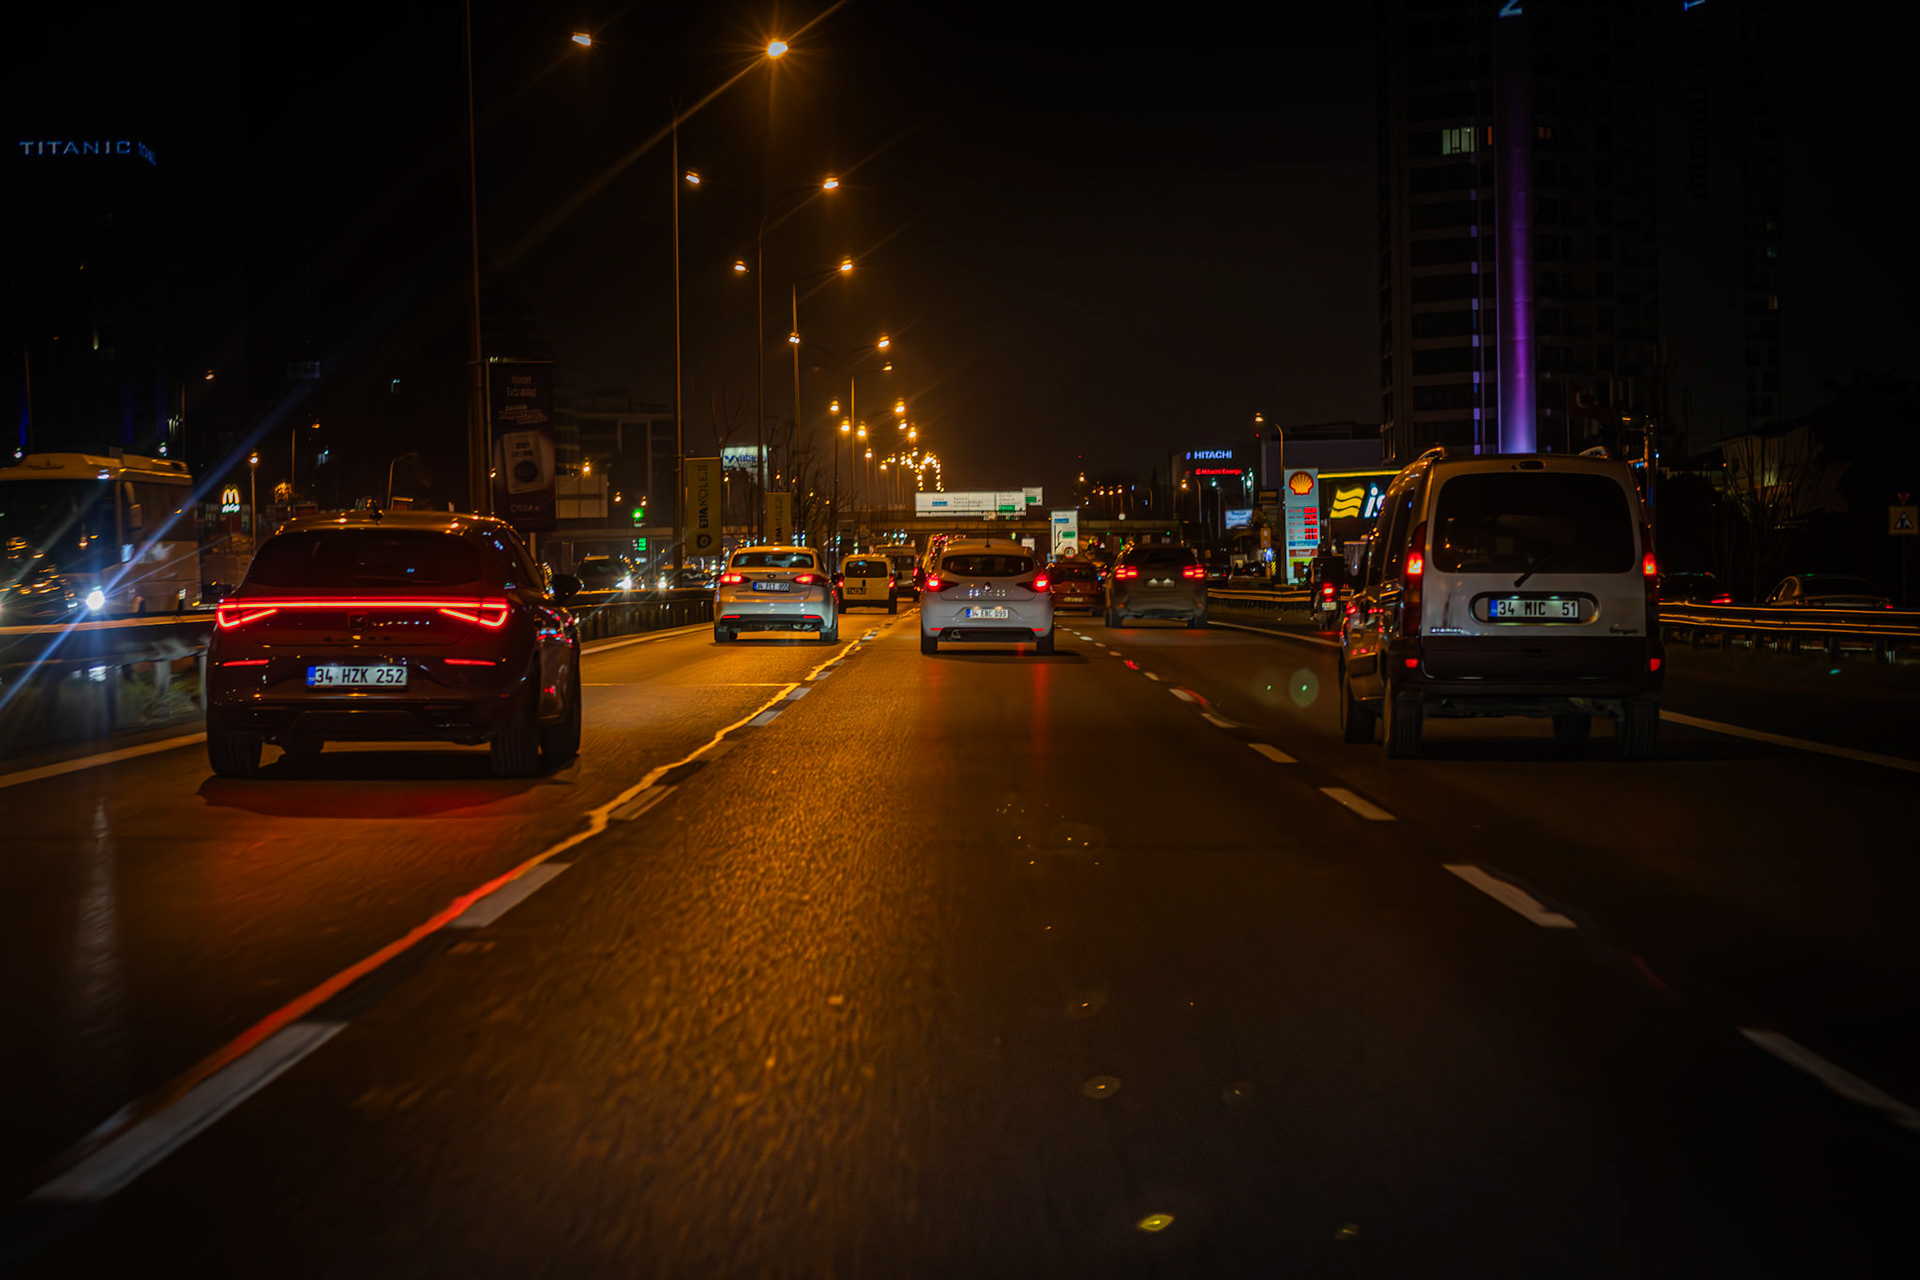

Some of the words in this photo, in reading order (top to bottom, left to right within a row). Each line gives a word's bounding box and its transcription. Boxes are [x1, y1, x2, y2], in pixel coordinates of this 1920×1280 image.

[18, 140, 132, 156] TITANIC
[1193, 450, 1233, 460] HITACHI
[1499, 601, 1515, 615] 34
[1525, 601, 1546, 615] MIC
[1562, 602, 1577, 616] 51
[314, 668, 333, 684] 34
[341, 668, 369, 684] HZK
[376, 668, 404, 684] 252
